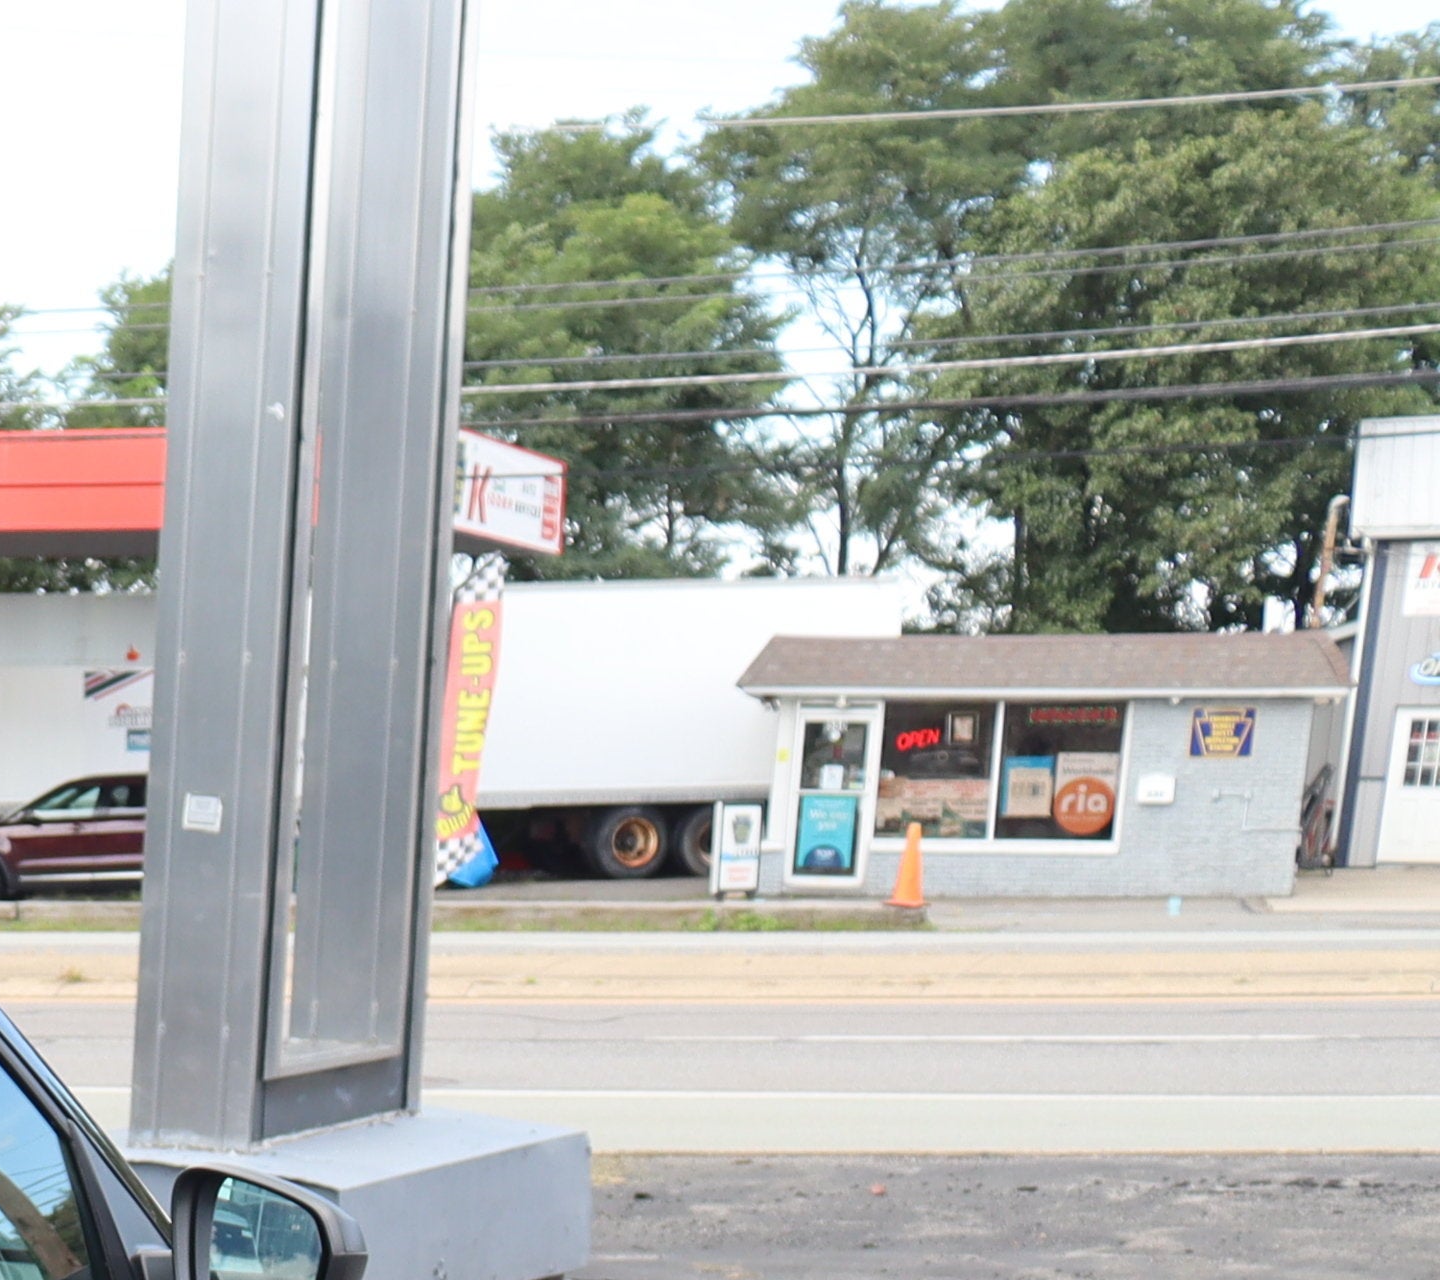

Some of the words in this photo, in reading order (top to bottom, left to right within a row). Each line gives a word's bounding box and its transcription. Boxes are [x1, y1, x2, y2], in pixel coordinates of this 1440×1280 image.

[453, 607, 495, 775] TUNE-UPS
[896, 728, 941, 751] OPEN
[1060, 785, 1108, 814] ria
